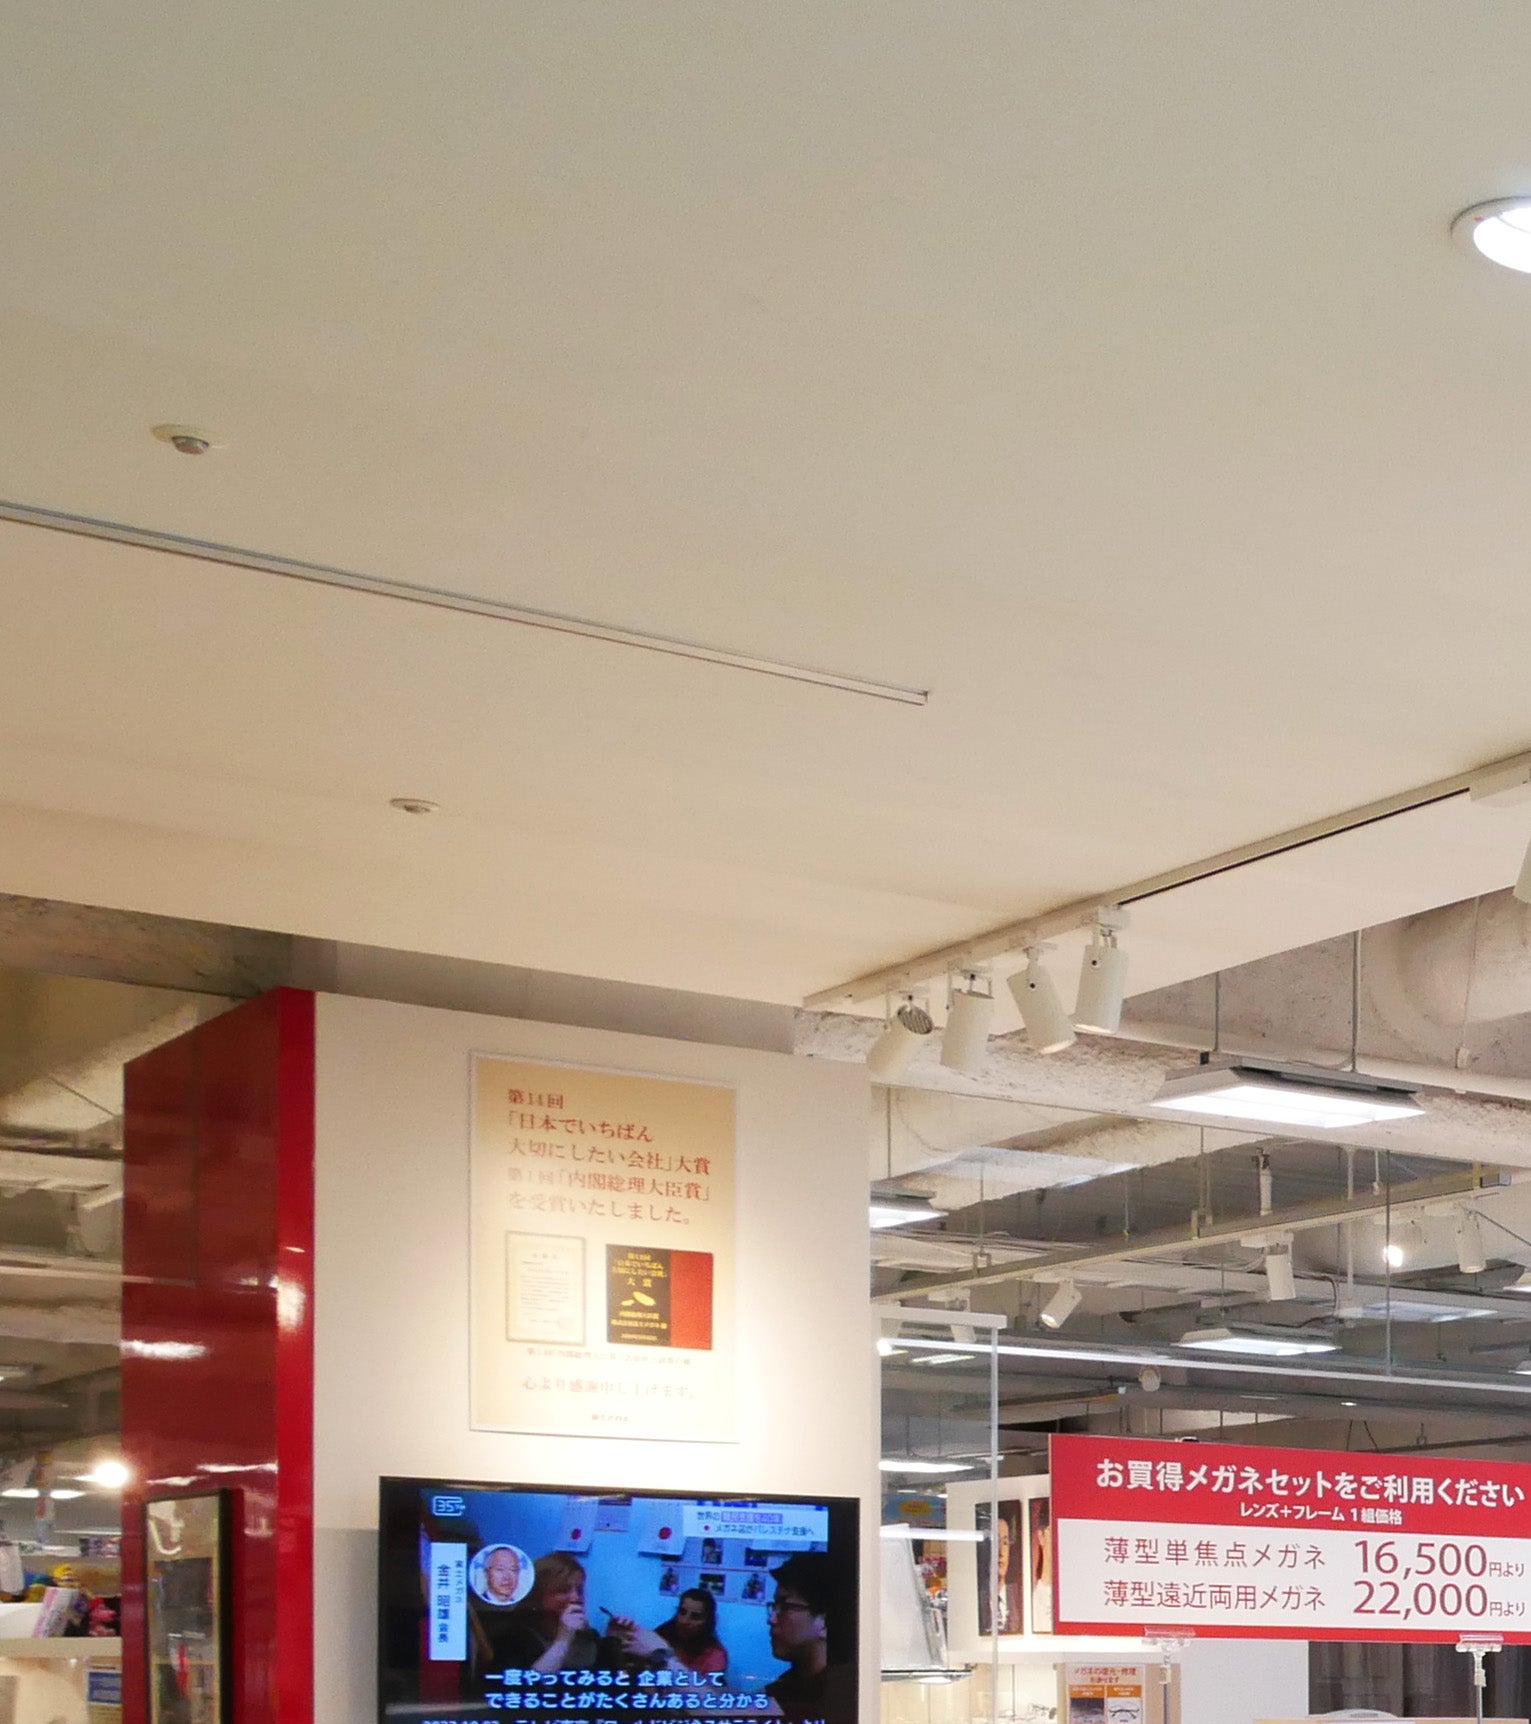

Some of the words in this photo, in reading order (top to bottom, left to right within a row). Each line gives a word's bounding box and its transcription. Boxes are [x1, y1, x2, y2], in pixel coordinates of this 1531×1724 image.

[509, 1110, 652, 1142] 「日本でいちばん
[1096, 1458, 1525, 1508] お買得メガネセットをご利用ください
[1104, 1536, 1326, 1570] 薄型単焦点メガネ
[1103, 1578, 1326, 1612] 薄型遠近両用メガネ
[485, 1670, 630, 1687] 一度やってみると
[638, 1670, 725, 1687] 企業として
[485, 1692, 769, 1710] できることがたくさんあると分かる
